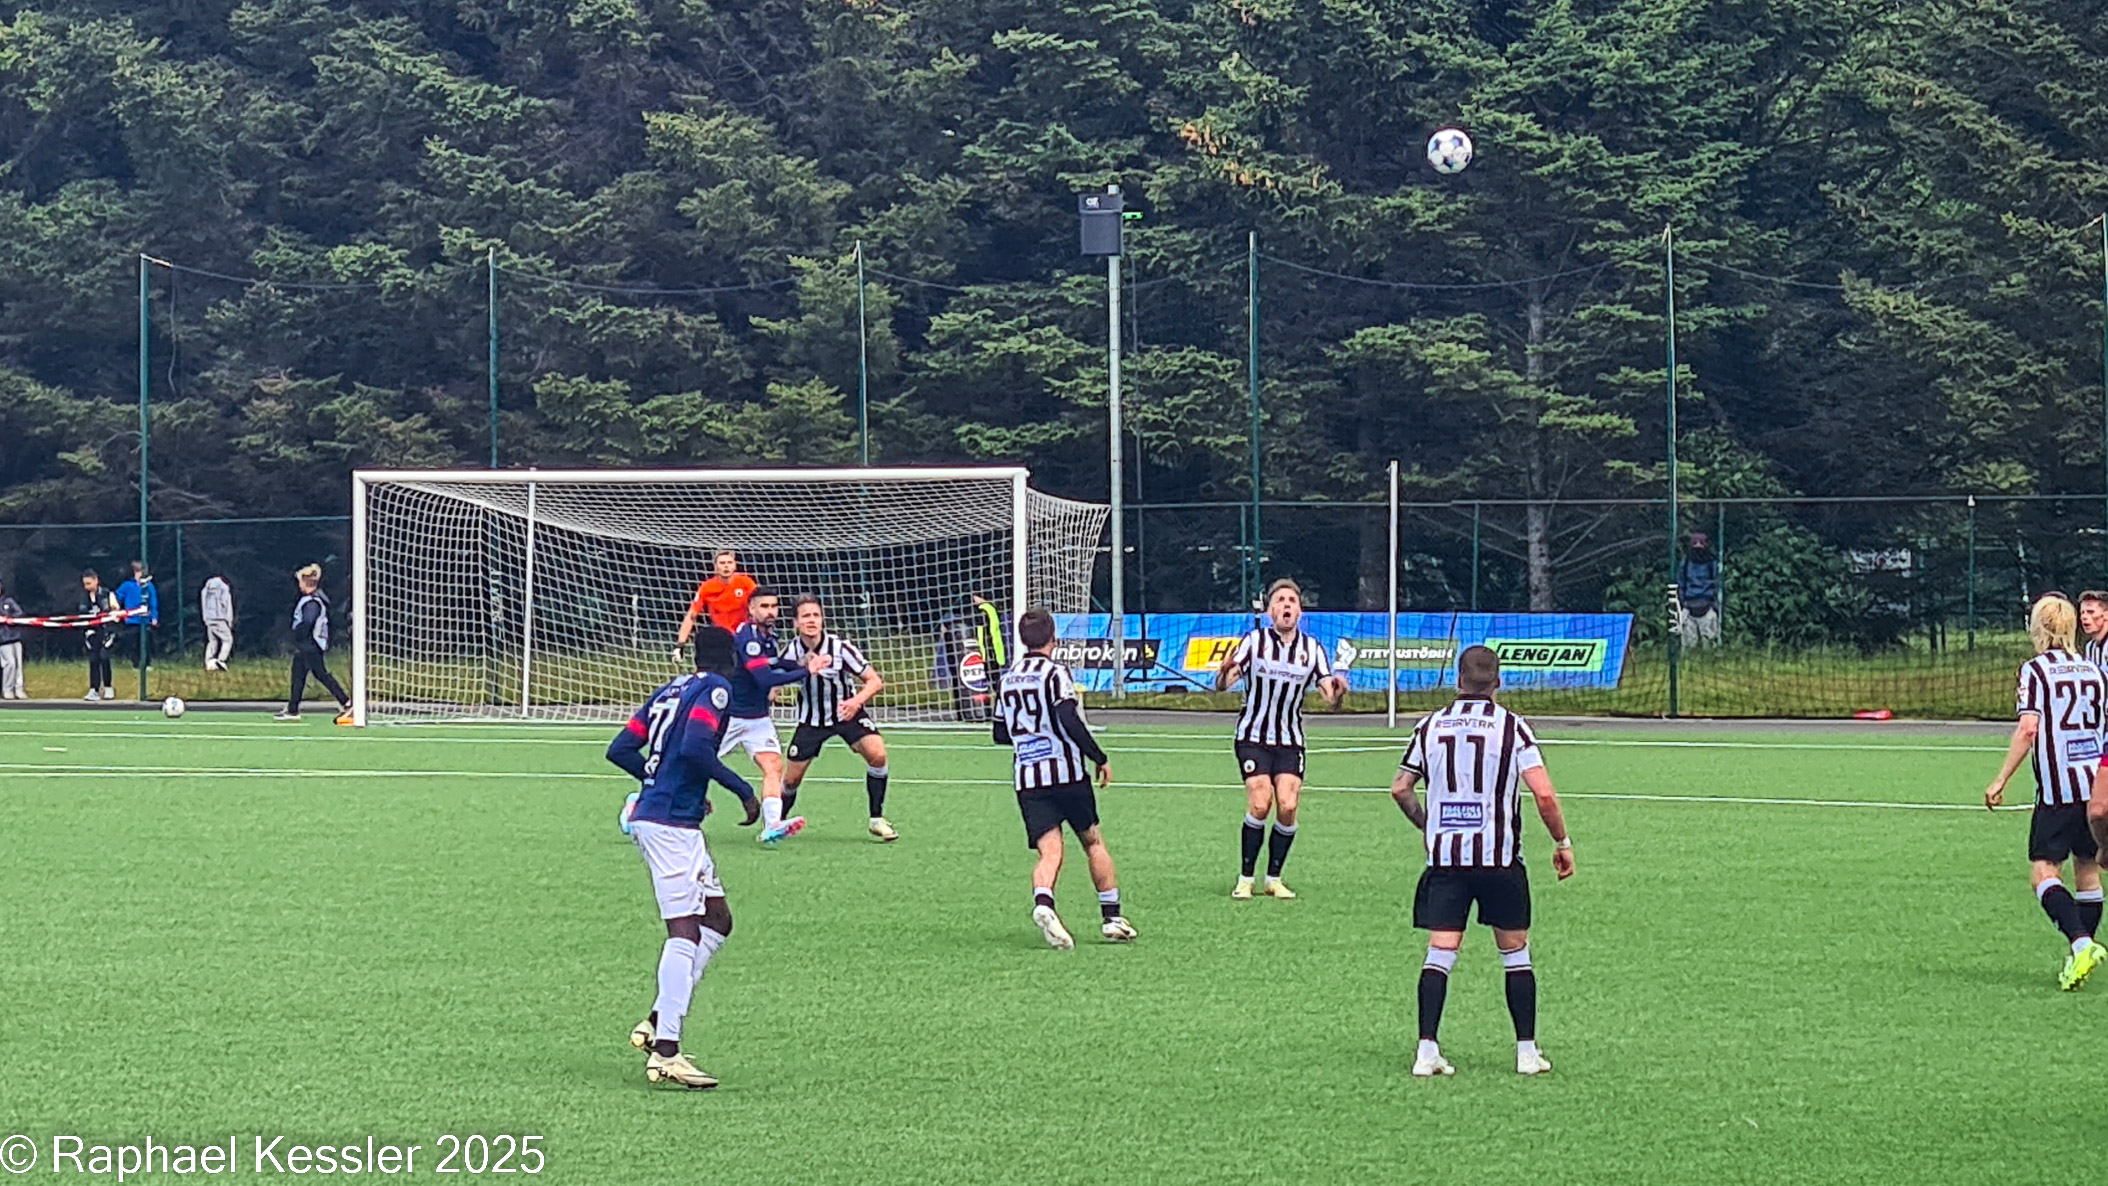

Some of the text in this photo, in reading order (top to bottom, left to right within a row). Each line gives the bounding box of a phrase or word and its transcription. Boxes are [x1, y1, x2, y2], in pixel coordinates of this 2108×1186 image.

[1500, 647, 1588, 661] LENGJAN
[1003, 688, 1043, 737] 29
[2055, 679, 2101, 731] 23
[1437, 734, 1486, 794] 11
